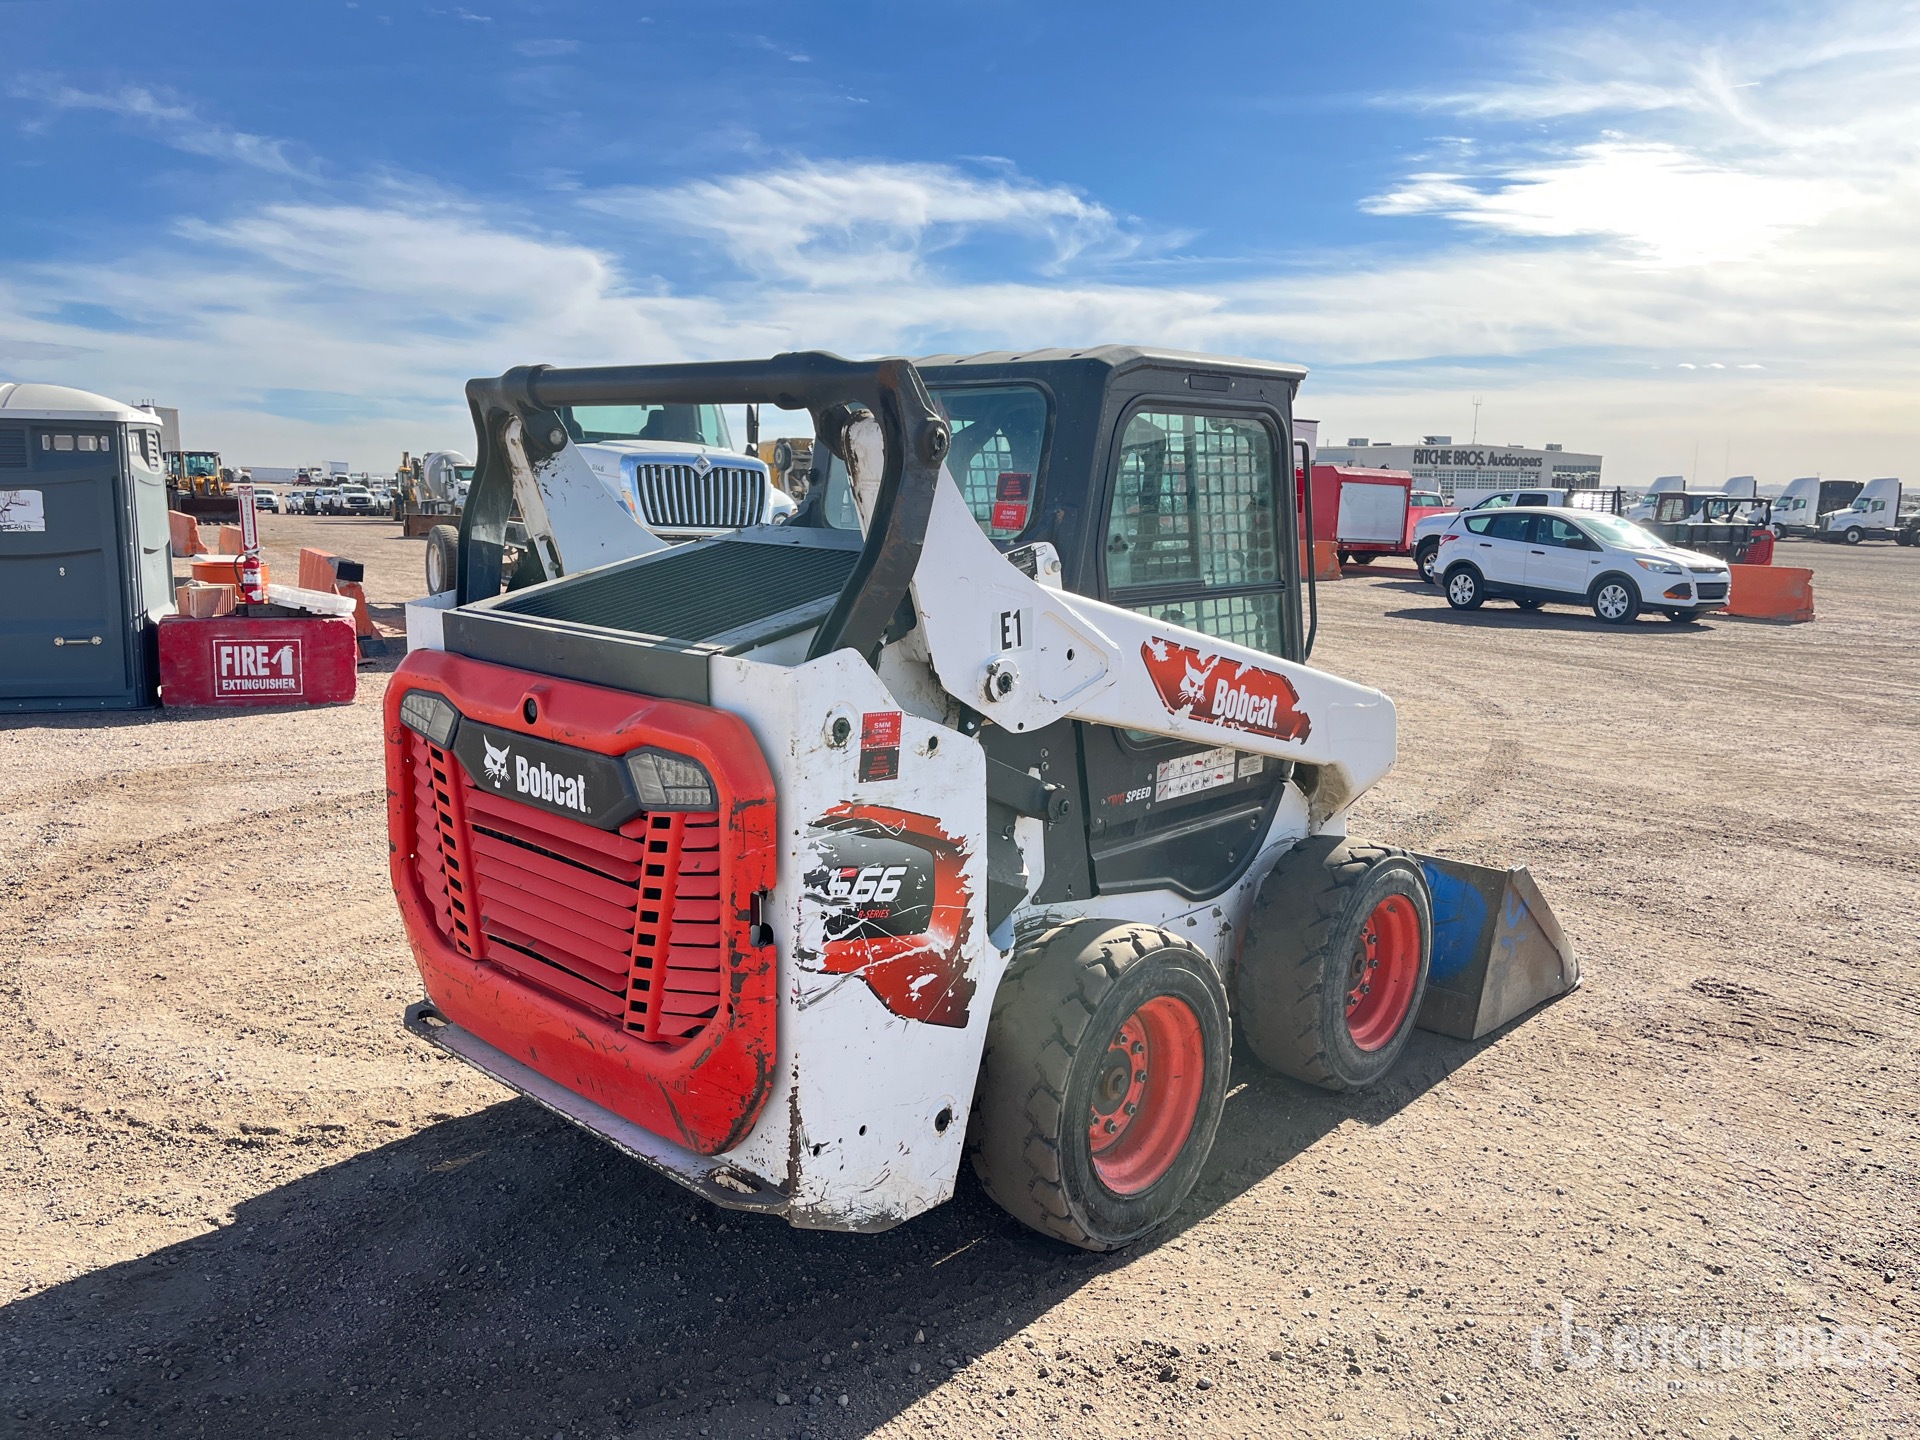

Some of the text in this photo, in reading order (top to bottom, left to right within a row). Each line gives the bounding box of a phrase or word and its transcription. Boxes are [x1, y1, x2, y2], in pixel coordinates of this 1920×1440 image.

[1413, 449, 1543, 468] RITCHIE BROS. Auctioneers
[1000, 608, 1022, 651] E1
[220, 645, 270, 677] FIRE
[222, 678, 296, 691] EXTINGUISHER
[1211, 678, 1278, 729] Bobcat
[515, 754, 587, 813] Bobcat
[1125, 786, 1152, 803] SPEED
[857, 909, 890, 919] R-SERIES
